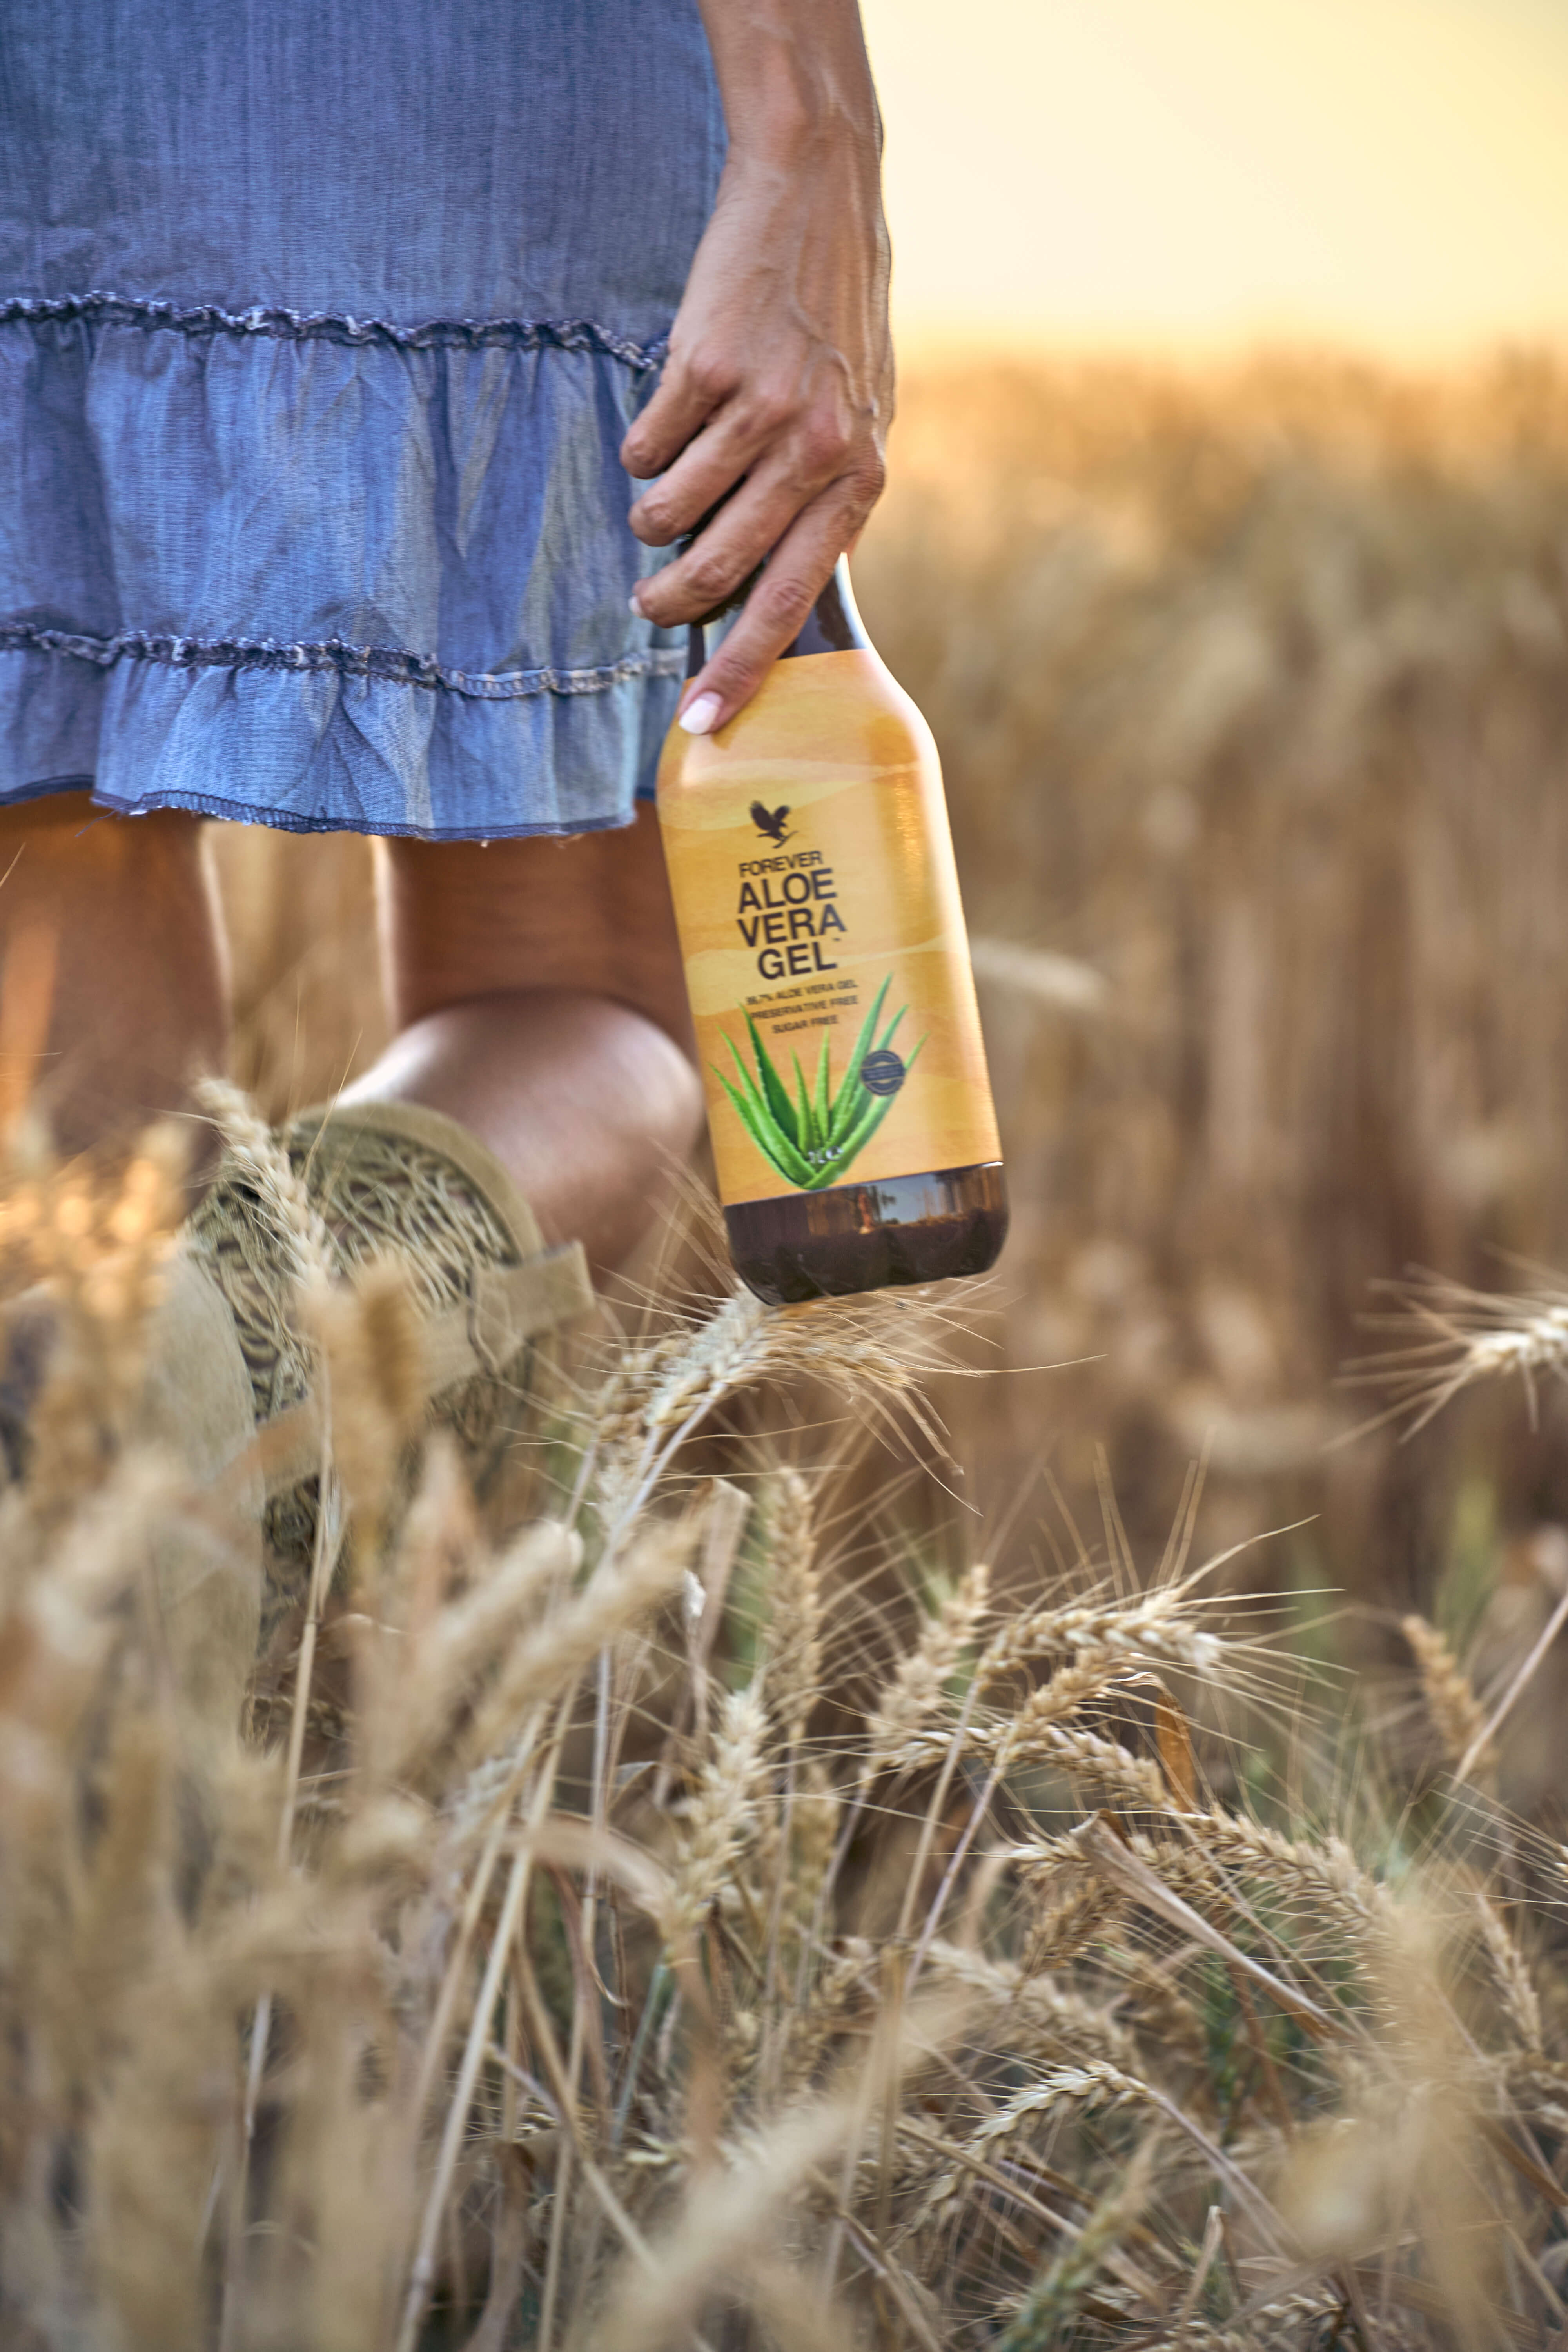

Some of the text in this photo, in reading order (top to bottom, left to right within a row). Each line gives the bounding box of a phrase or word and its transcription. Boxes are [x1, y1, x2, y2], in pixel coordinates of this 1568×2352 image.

[739, 851, 822, 877] FOREVER
[738, 868, 837, 914] ALOE
[737, 904, 847, 947] VERA
[757, 942, 837, 980] GEL
[771, 1020, 808, 1033] SUGAR
